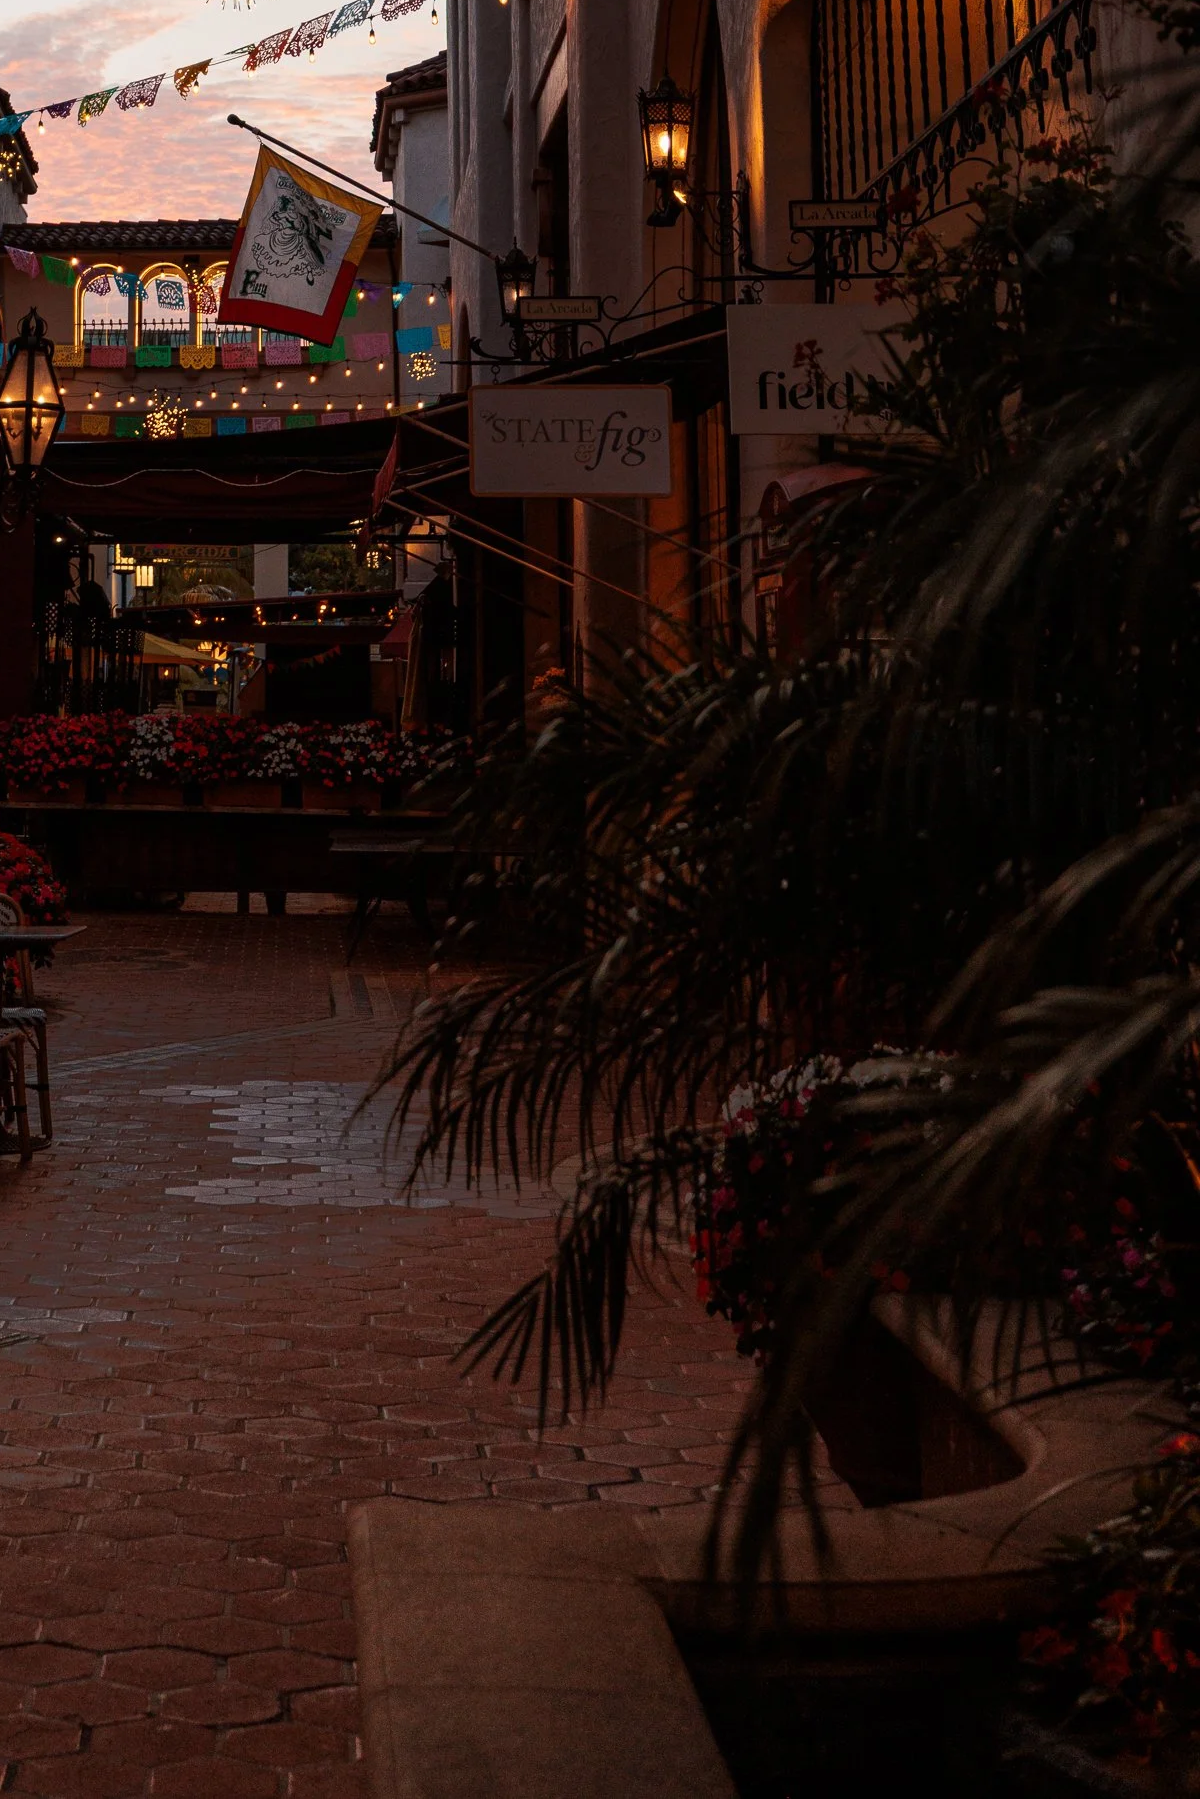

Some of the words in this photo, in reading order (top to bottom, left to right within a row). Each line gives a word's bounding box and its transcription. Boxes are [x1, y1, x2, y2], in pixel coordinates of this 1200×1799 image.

[799, 206, 819, 220] La
[823, 205, 877, 220] Arcada
[527, 302, 543, 314] La
[547, 302, 592, 314] Arcada
[756, 370, 855, 411] field
[490, 417, 596, 443] STATE
[574, 445, 596, 463] &
[585, 410, 661, 471] fig
